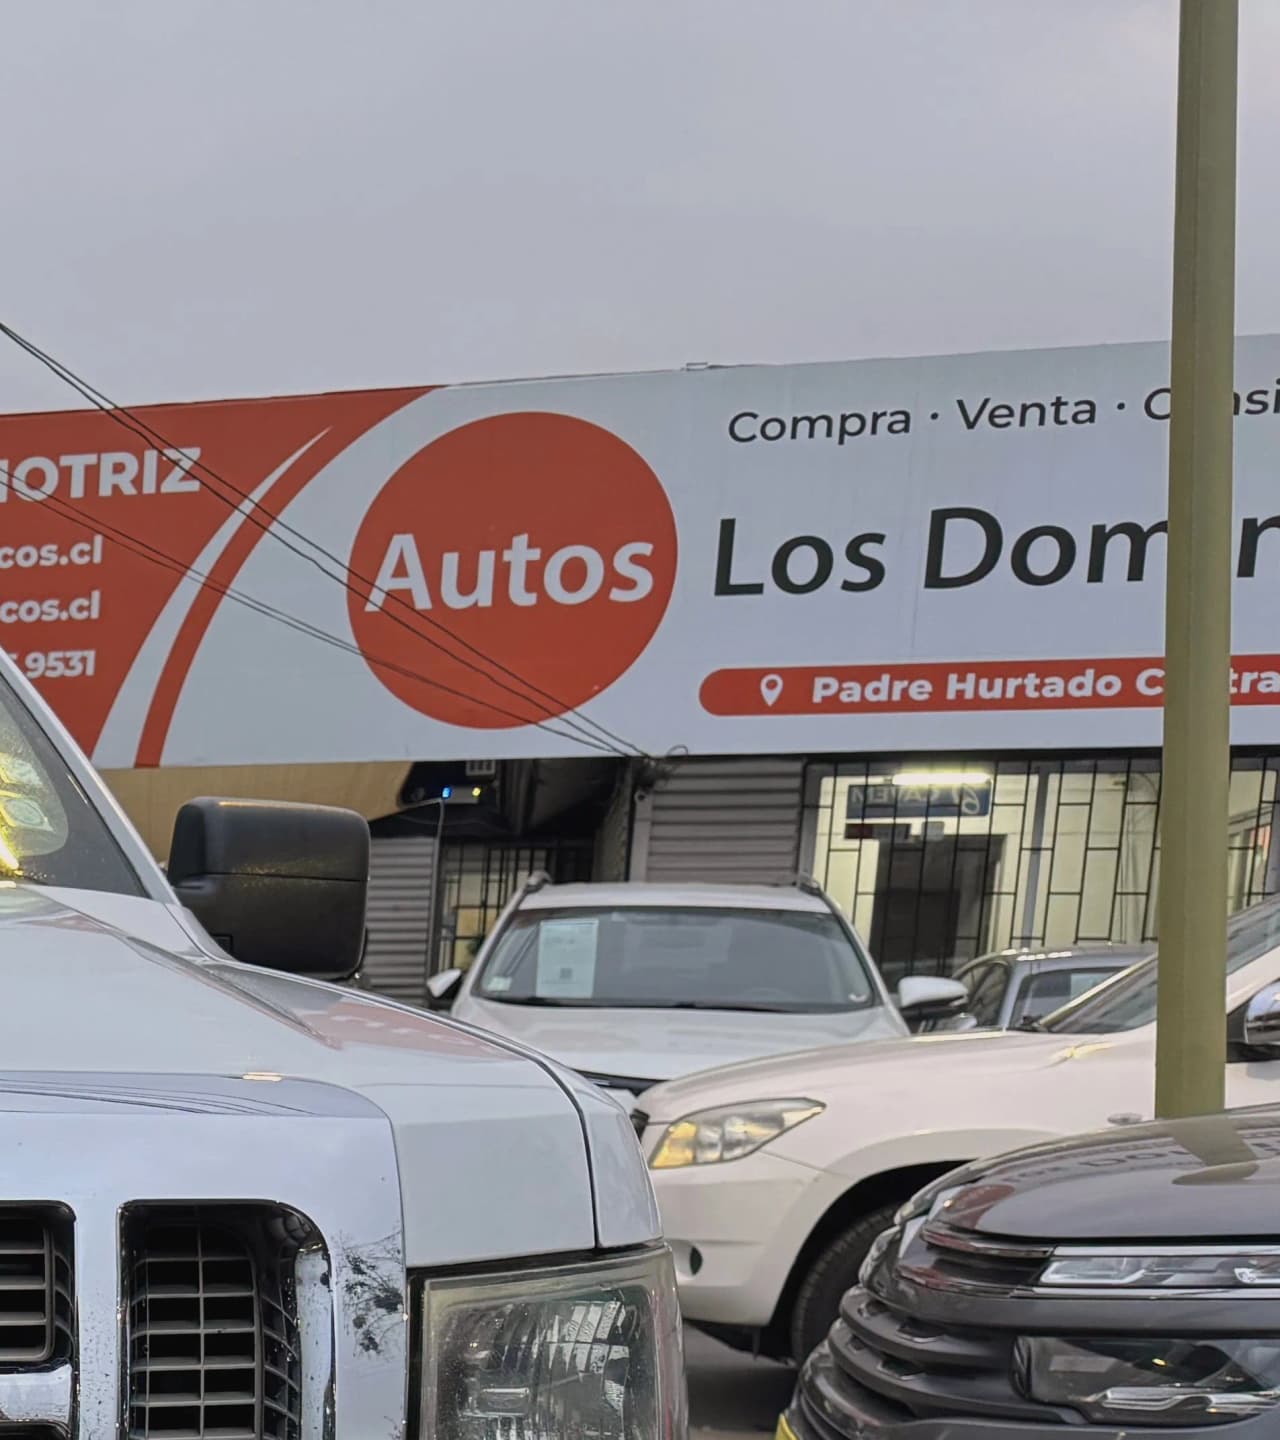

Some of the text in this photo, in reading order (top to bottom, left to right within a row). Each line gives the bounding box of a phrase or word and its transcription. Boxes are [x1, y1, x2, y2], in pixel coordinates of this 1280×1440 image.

[727, 378, 1280, 446] Compra Venta Csi
[363, 533, 654, 612] Autos
[714, 506, 1280, 597] Los Domn
[811, 667, 1280, 704] Padre Hurtado Ctra
